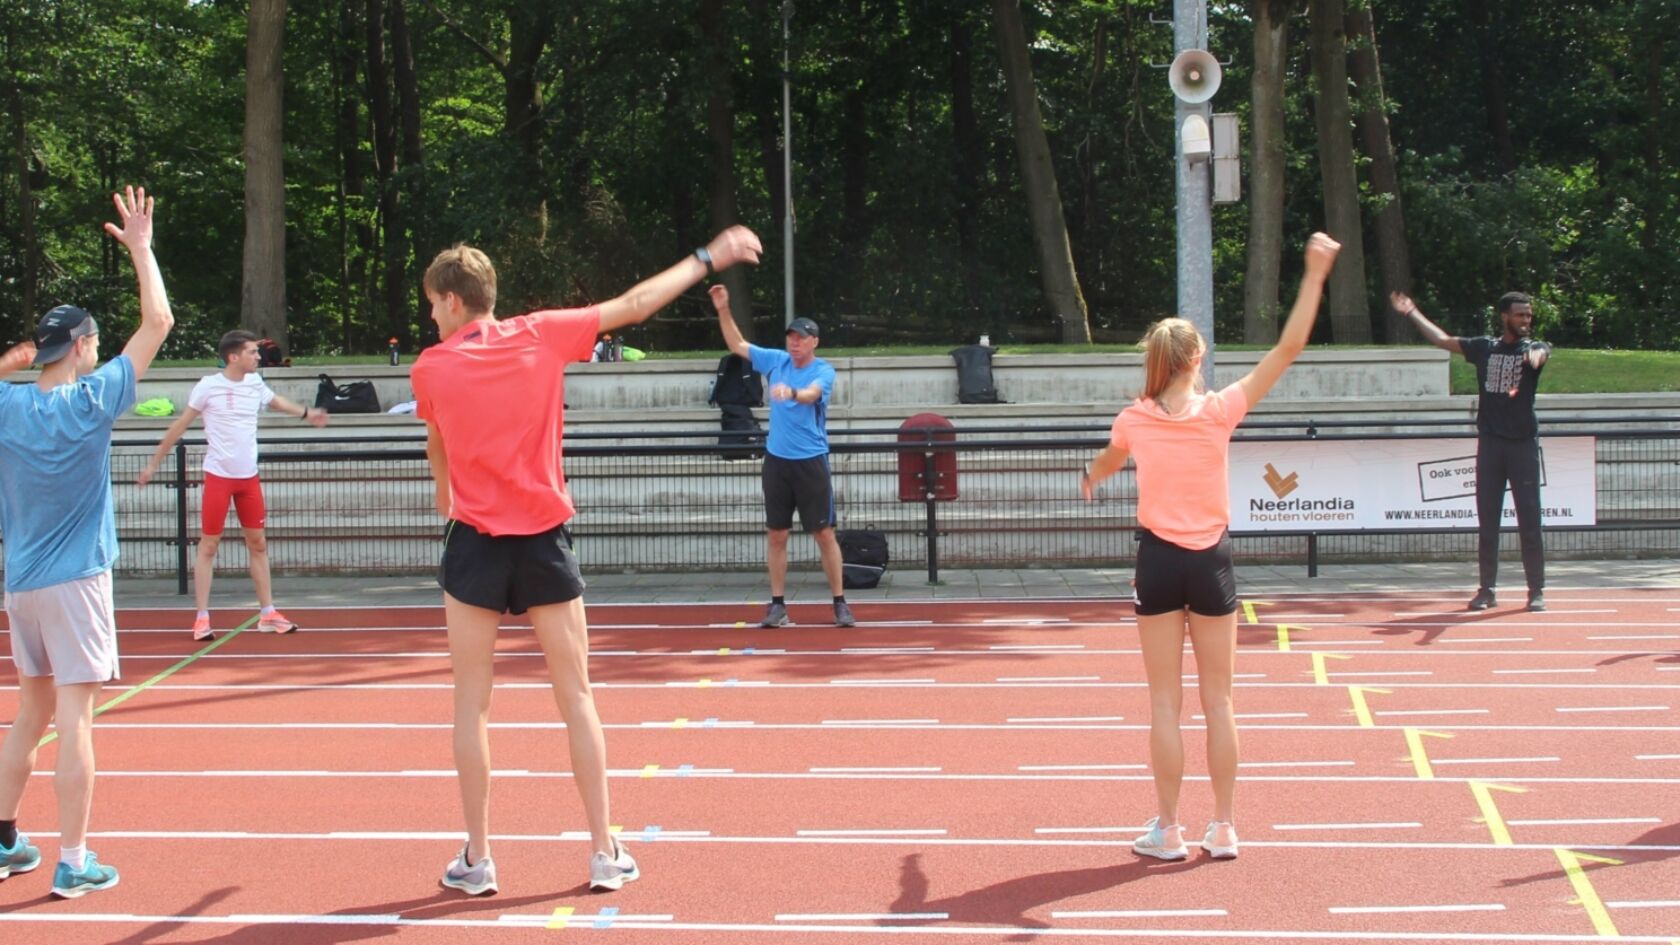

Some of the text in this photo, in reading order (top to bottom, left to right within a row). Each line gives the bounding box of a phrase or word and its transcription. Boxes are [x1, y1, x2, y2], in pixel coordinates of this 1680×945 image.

[1429, 468, 1452, 479] Ook
[1250, 498, 1355, 511] Neerlandia
[1250, 511, 1355, 522] houten vloeren
